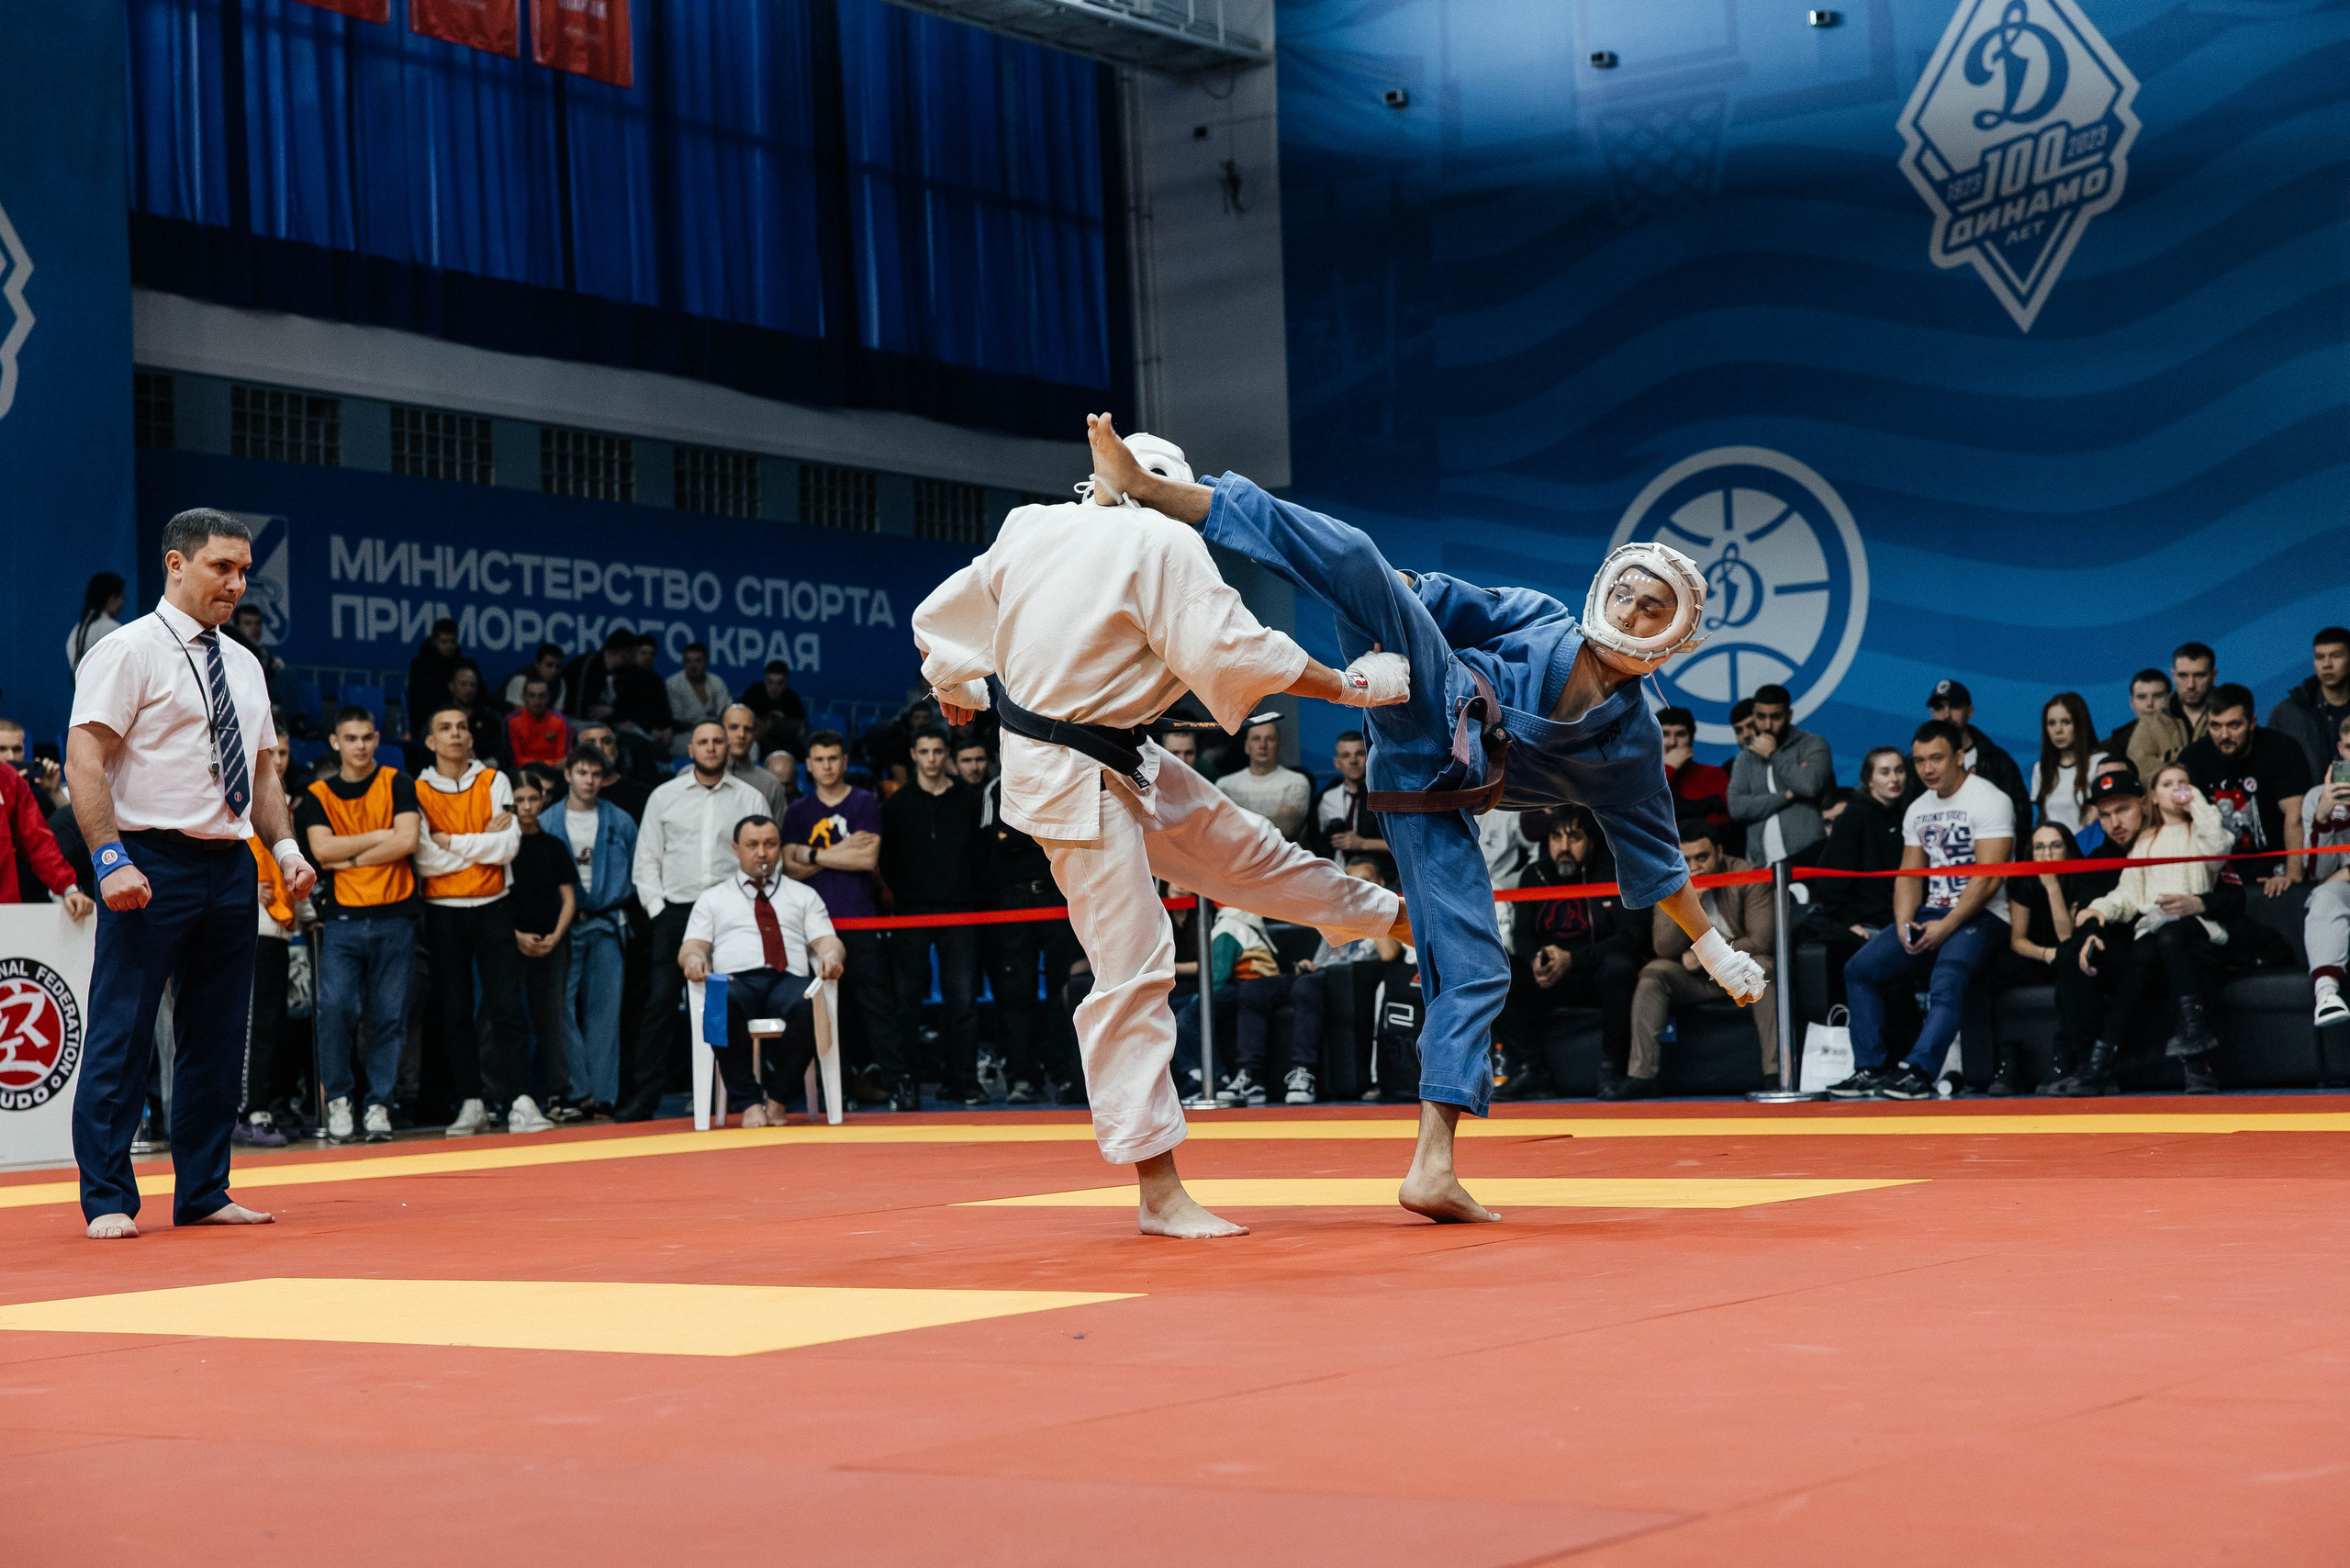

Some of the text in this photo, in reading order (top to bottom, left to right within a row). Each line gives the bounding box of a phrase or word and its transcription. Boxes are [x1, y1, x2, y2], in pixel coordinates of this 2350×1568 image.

[1947, 166, 2109, 247] ДИНАМО
[330, 535, 896, 628] МИНИСТЕРСТВО СПОРТА
[709, 624, 821, 672] КРАЯ
[35, 965, 81, 1077] FEDERATION
